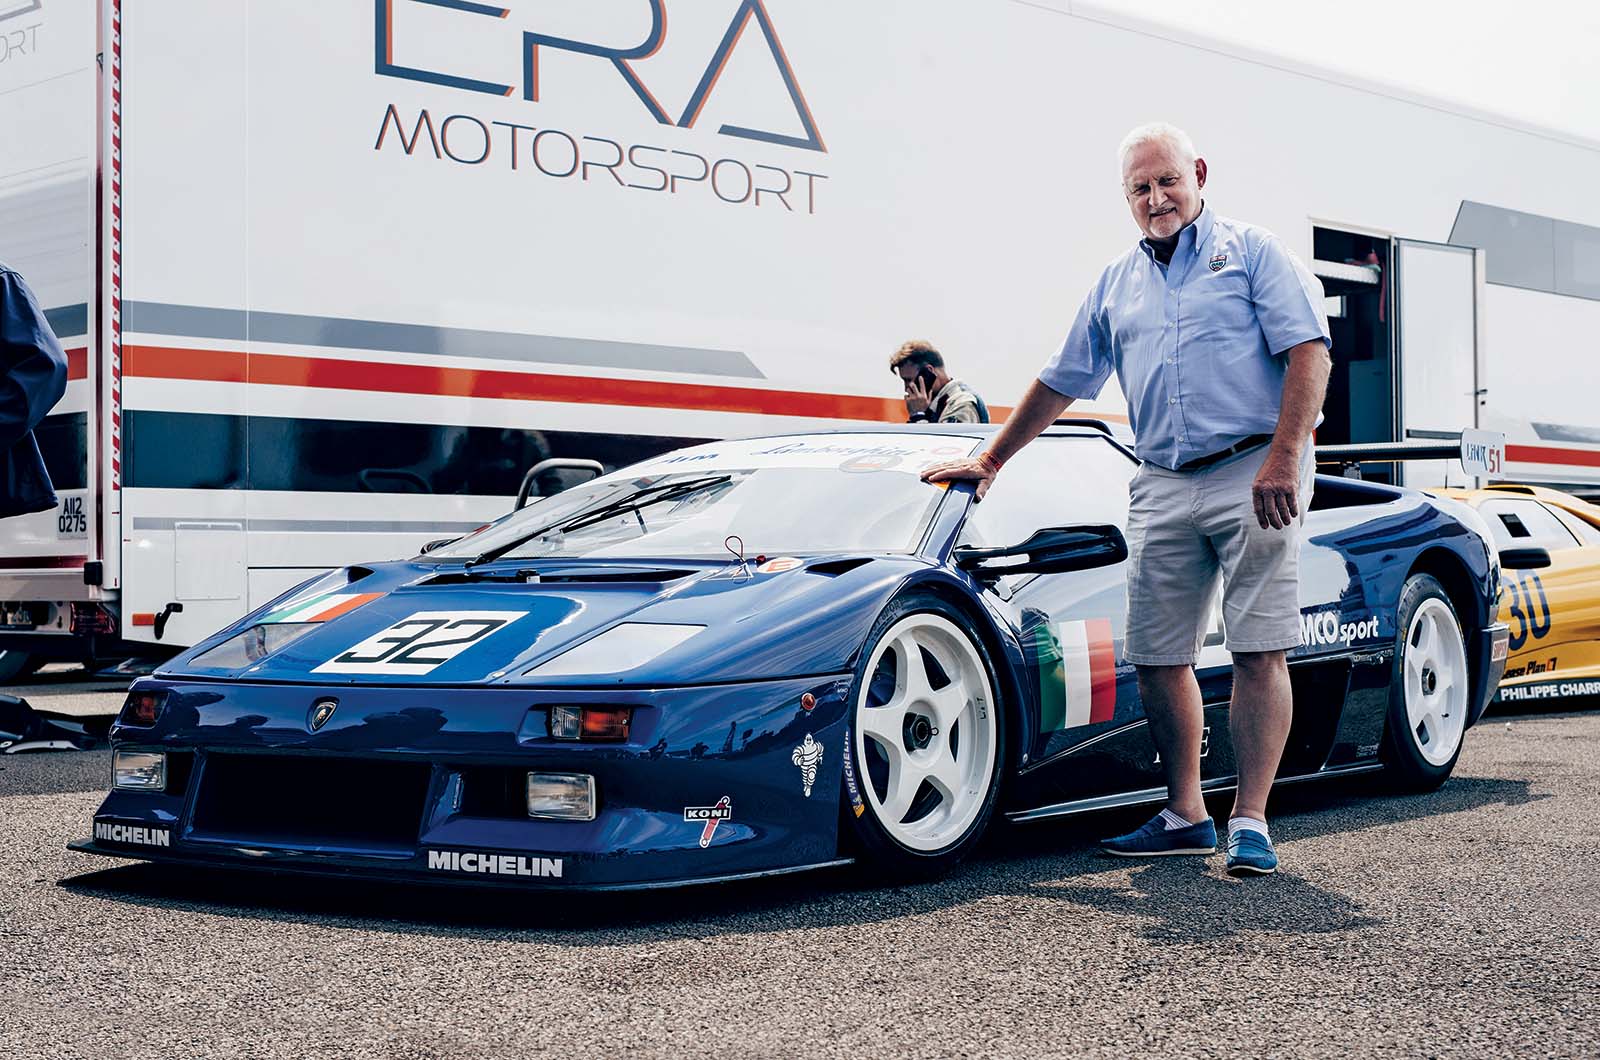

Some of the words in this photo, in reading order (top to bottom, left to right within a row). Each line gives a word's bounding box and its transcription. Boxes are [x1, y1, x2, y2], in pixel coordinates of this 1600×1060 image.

[375, 0, 829, 153] ERA
[375, 103, 829, 214] MOTORSPORT
[1489, 448, 1501, 473] 51
[58, 514, 87, 533] 0275
[1500, 570, 1551, 651] 30
[334, 619, 508, 665] 32
[1339, 615, 1379, 647] sport
[1526, 660, 1546, 675] Plan
[1500, 684, 1559, 701] PHILIPPE
[687, 809, 728, 818] KONI
[95, 822, 170, 847] MICHELIN
[428, 850, 563, 877] MICHELIN
